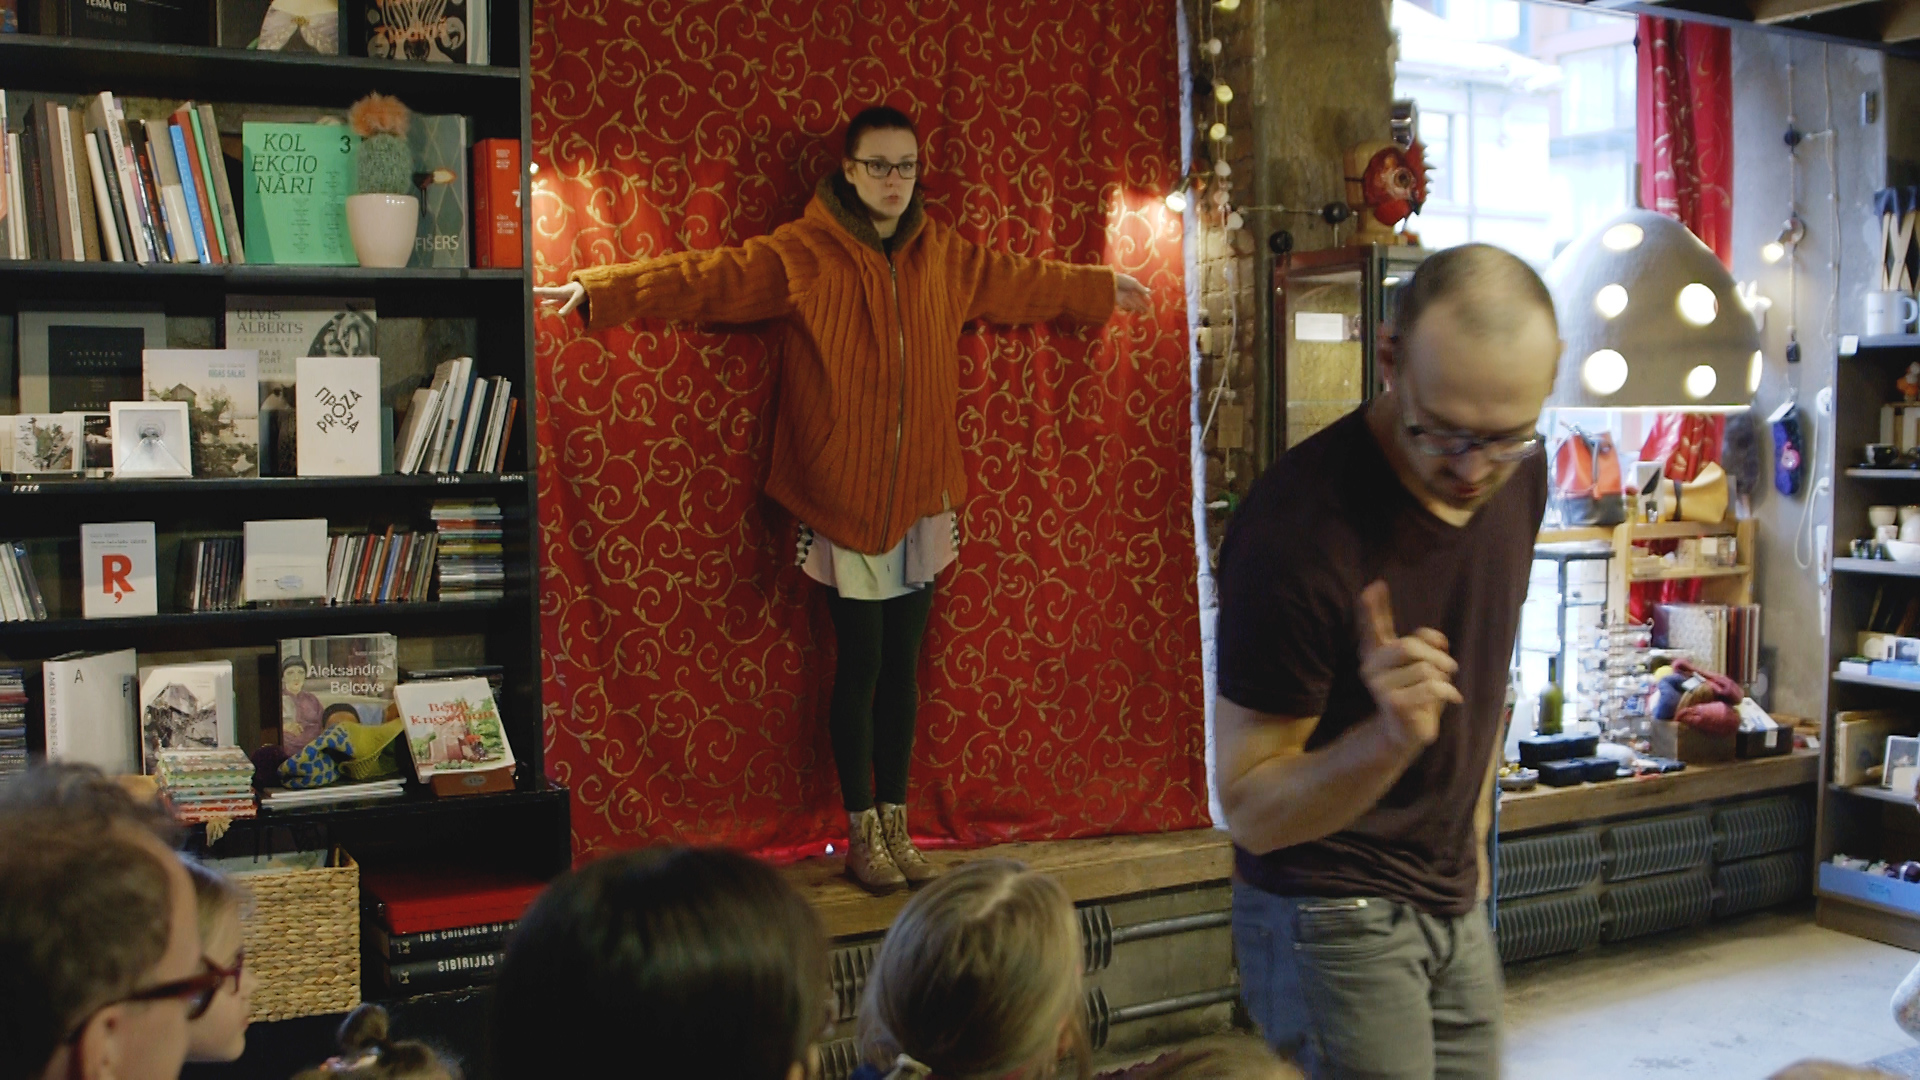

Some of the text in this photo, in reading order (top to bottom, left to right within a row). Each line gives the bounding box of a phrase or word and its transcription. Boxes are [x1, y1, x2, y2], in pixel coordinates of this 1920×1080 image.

[263, 133, 306, 152] KOL
[251, 155, 318, 174] EKCIO
[415, 234, 459, 252] FIŠERS
[236, 308, 282, 320] ULVIS
[236, 321, 304, 334] ALBERTS
[307, 664, 384, 678] Aleksandra
